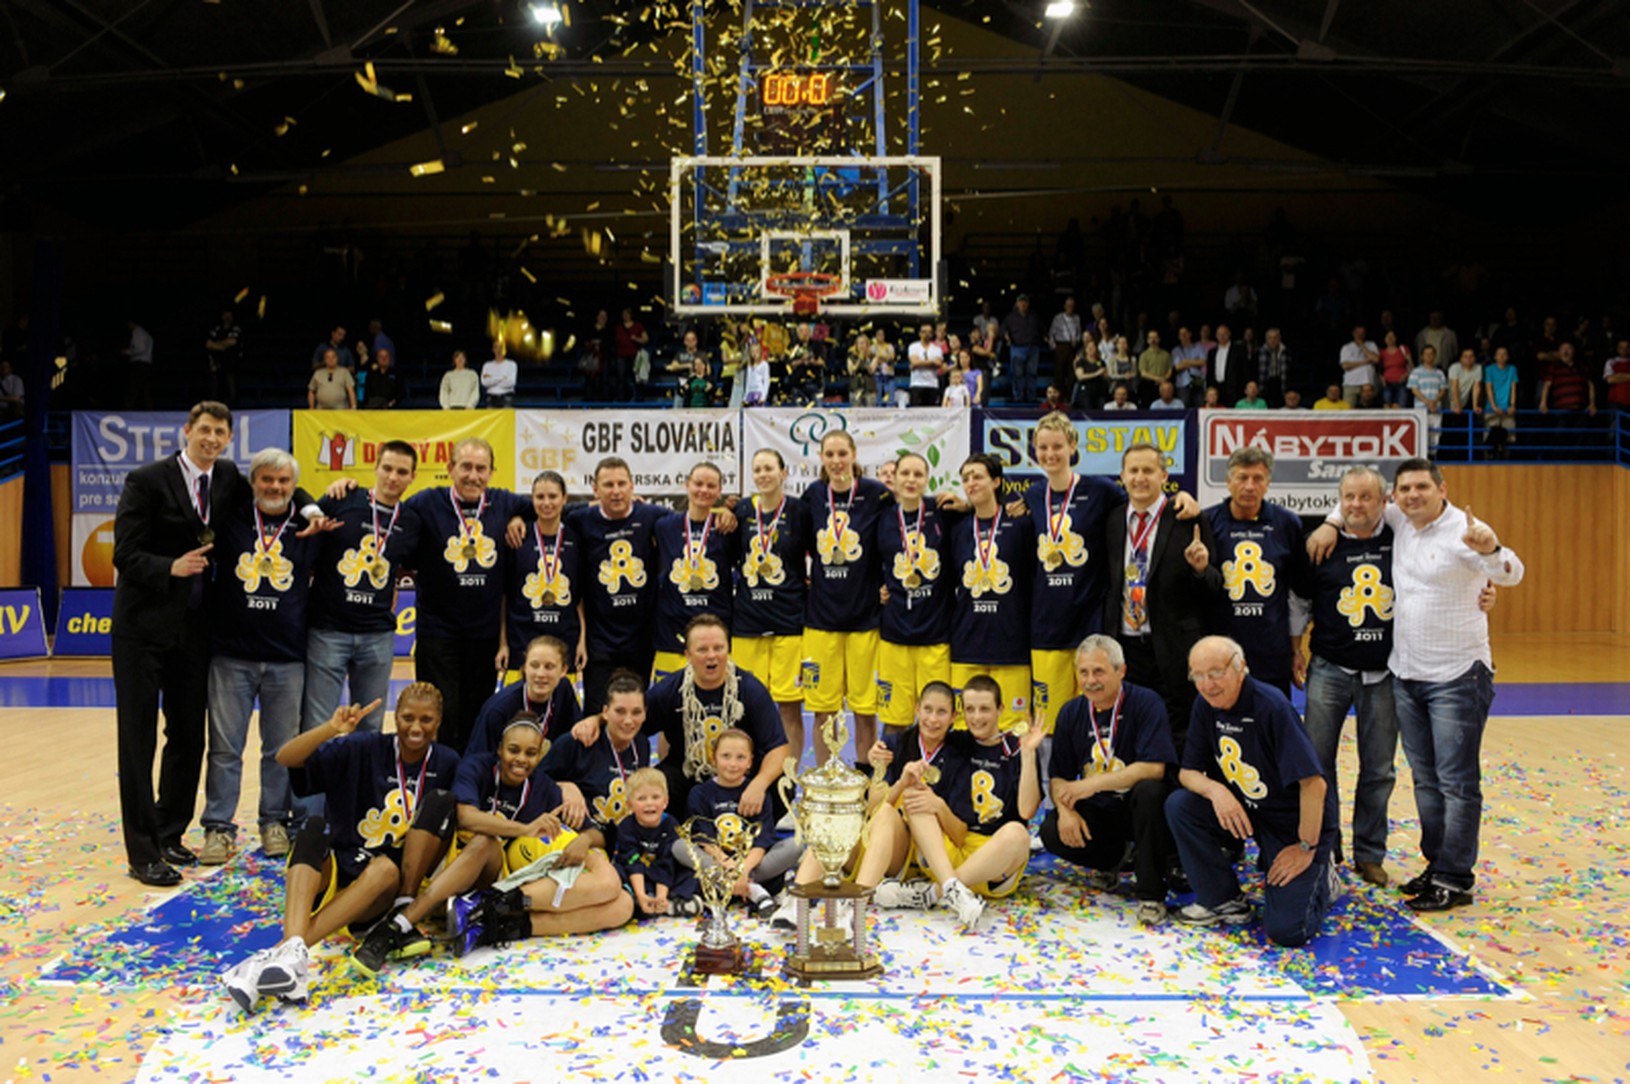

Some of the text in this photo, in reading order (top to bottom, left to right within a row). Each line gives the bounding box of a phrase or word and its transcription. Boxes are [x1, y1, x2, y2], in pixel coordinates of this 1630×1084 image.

[582, 421, 735, 454] GBF SLOVAKIA
[1086, 426, 1179, 453] STAV
[1214, 424, 1411, 458] NÁBYTOK
[520, 446, 577, 473] GBF
[79, 493, 102, 509] pre
[248, 600, 279, 611] 2011
[1234, 606, 1263, 616] 2011
[1354, 632, 1383, 641] 2011
